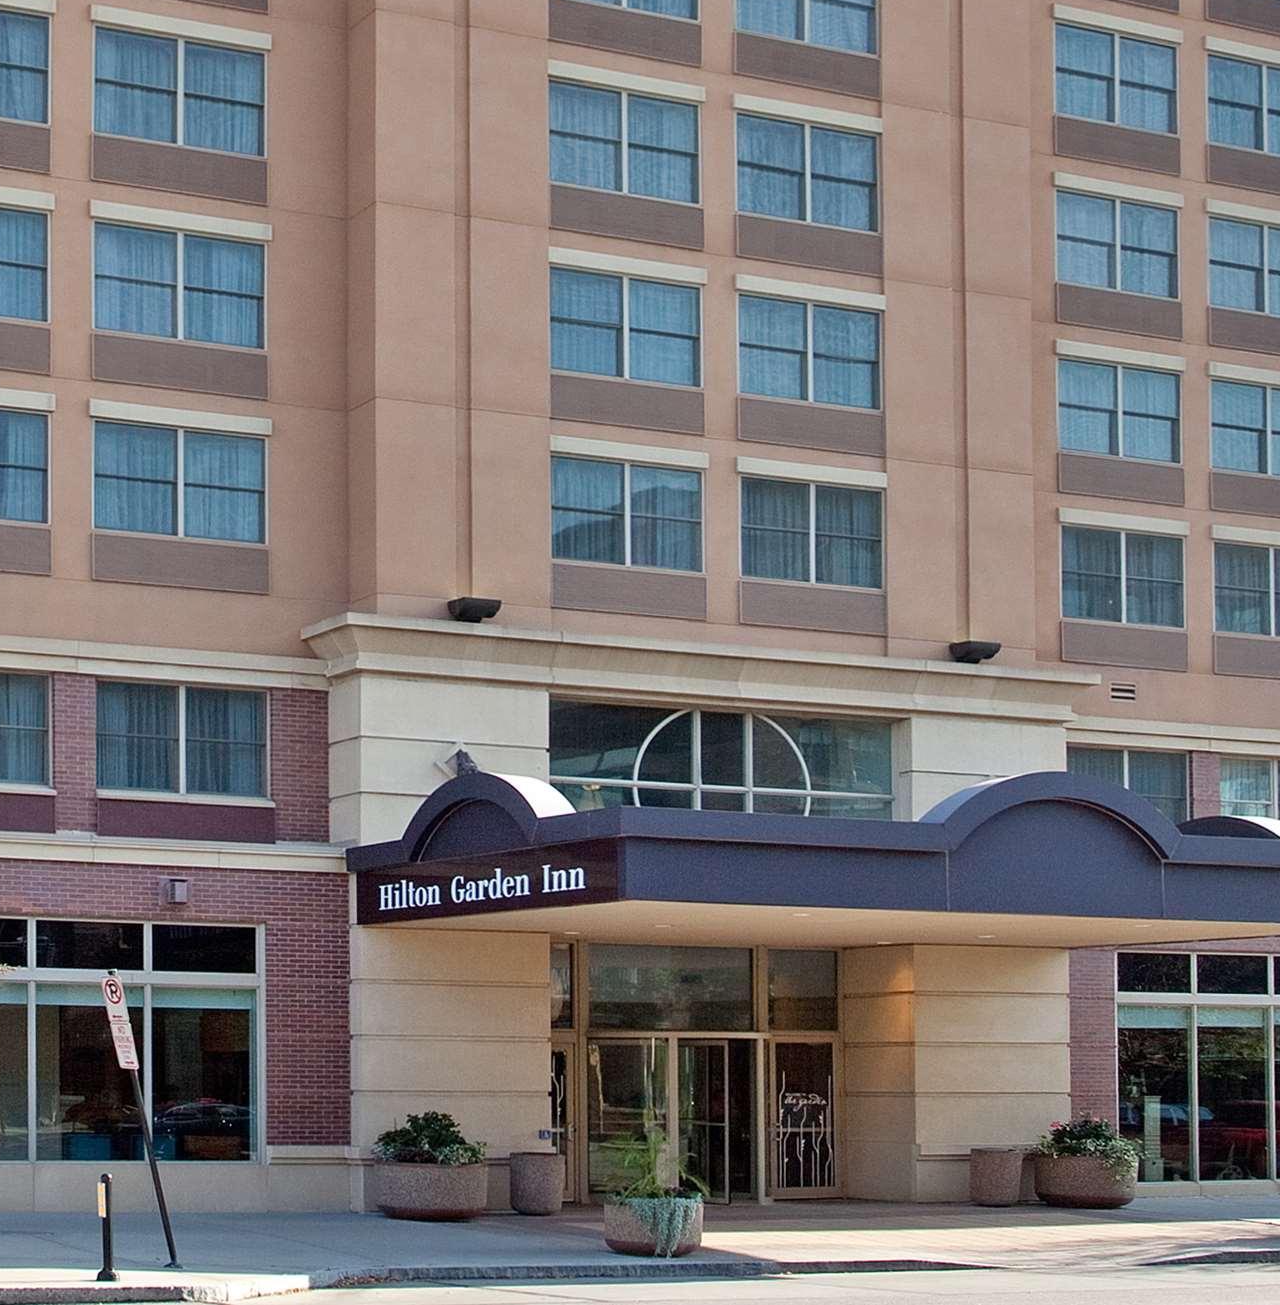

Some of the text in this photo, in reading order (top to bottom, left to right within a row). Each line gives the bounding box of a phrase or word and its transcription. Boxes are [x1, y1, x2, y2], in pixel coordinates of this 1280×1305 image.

[378, 864, 586, 911] Hilton Garden Inn
